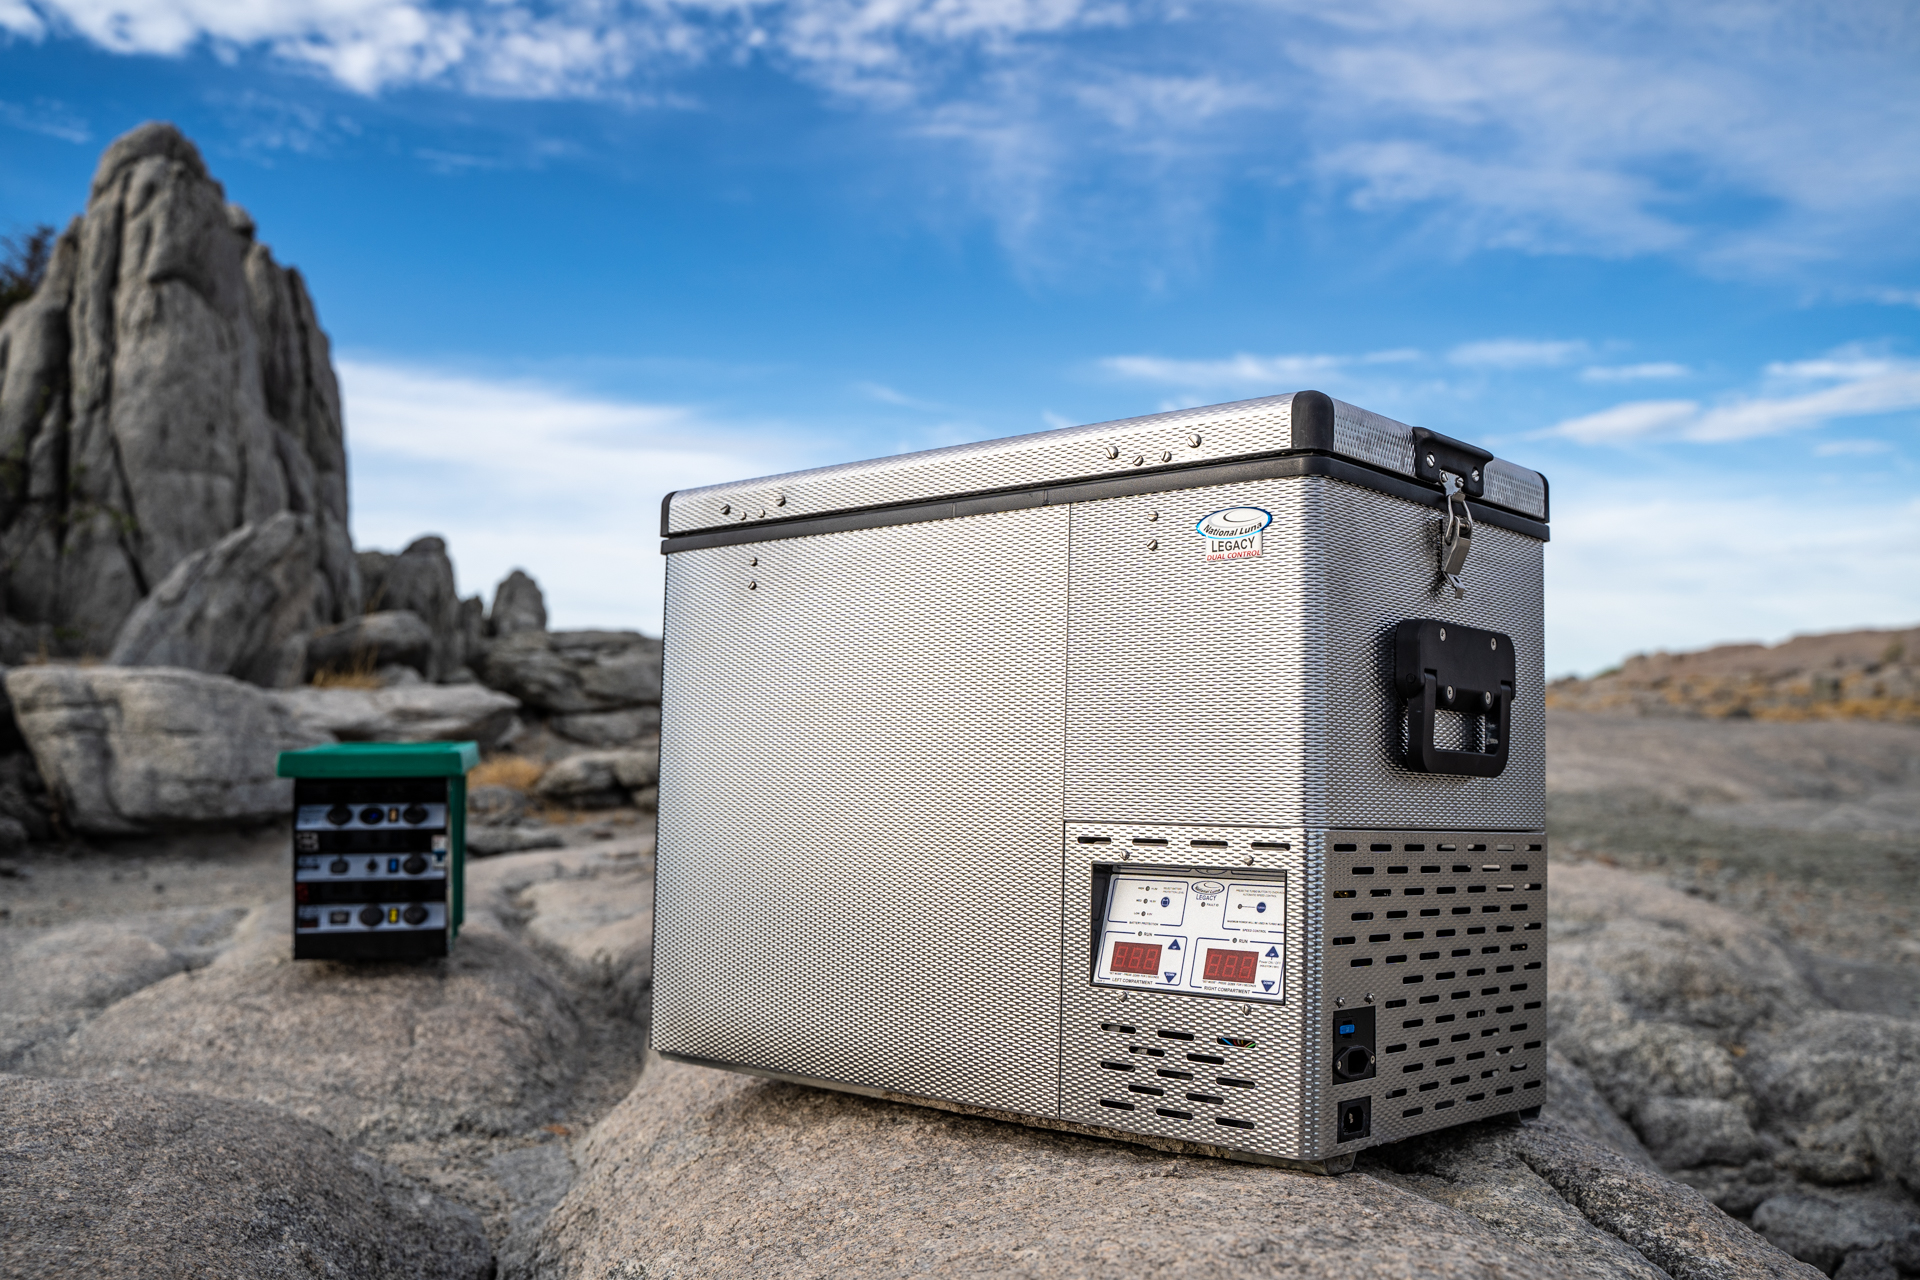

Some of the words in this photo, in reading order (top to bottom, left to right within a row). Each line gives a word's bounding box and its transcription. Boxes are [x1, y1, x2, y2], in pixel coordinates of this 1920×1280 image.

[1203, 524, 1238, 536] National
[1239, 522, 1262, 535] Luna
[1211, 536, 1256, 553] LEGACY
[1206, 553, 1225, 561] DUAL
[1227, 549, 1261, 559] CONTROL
[1217, 986, 1251, 994] COMPARTMENT
